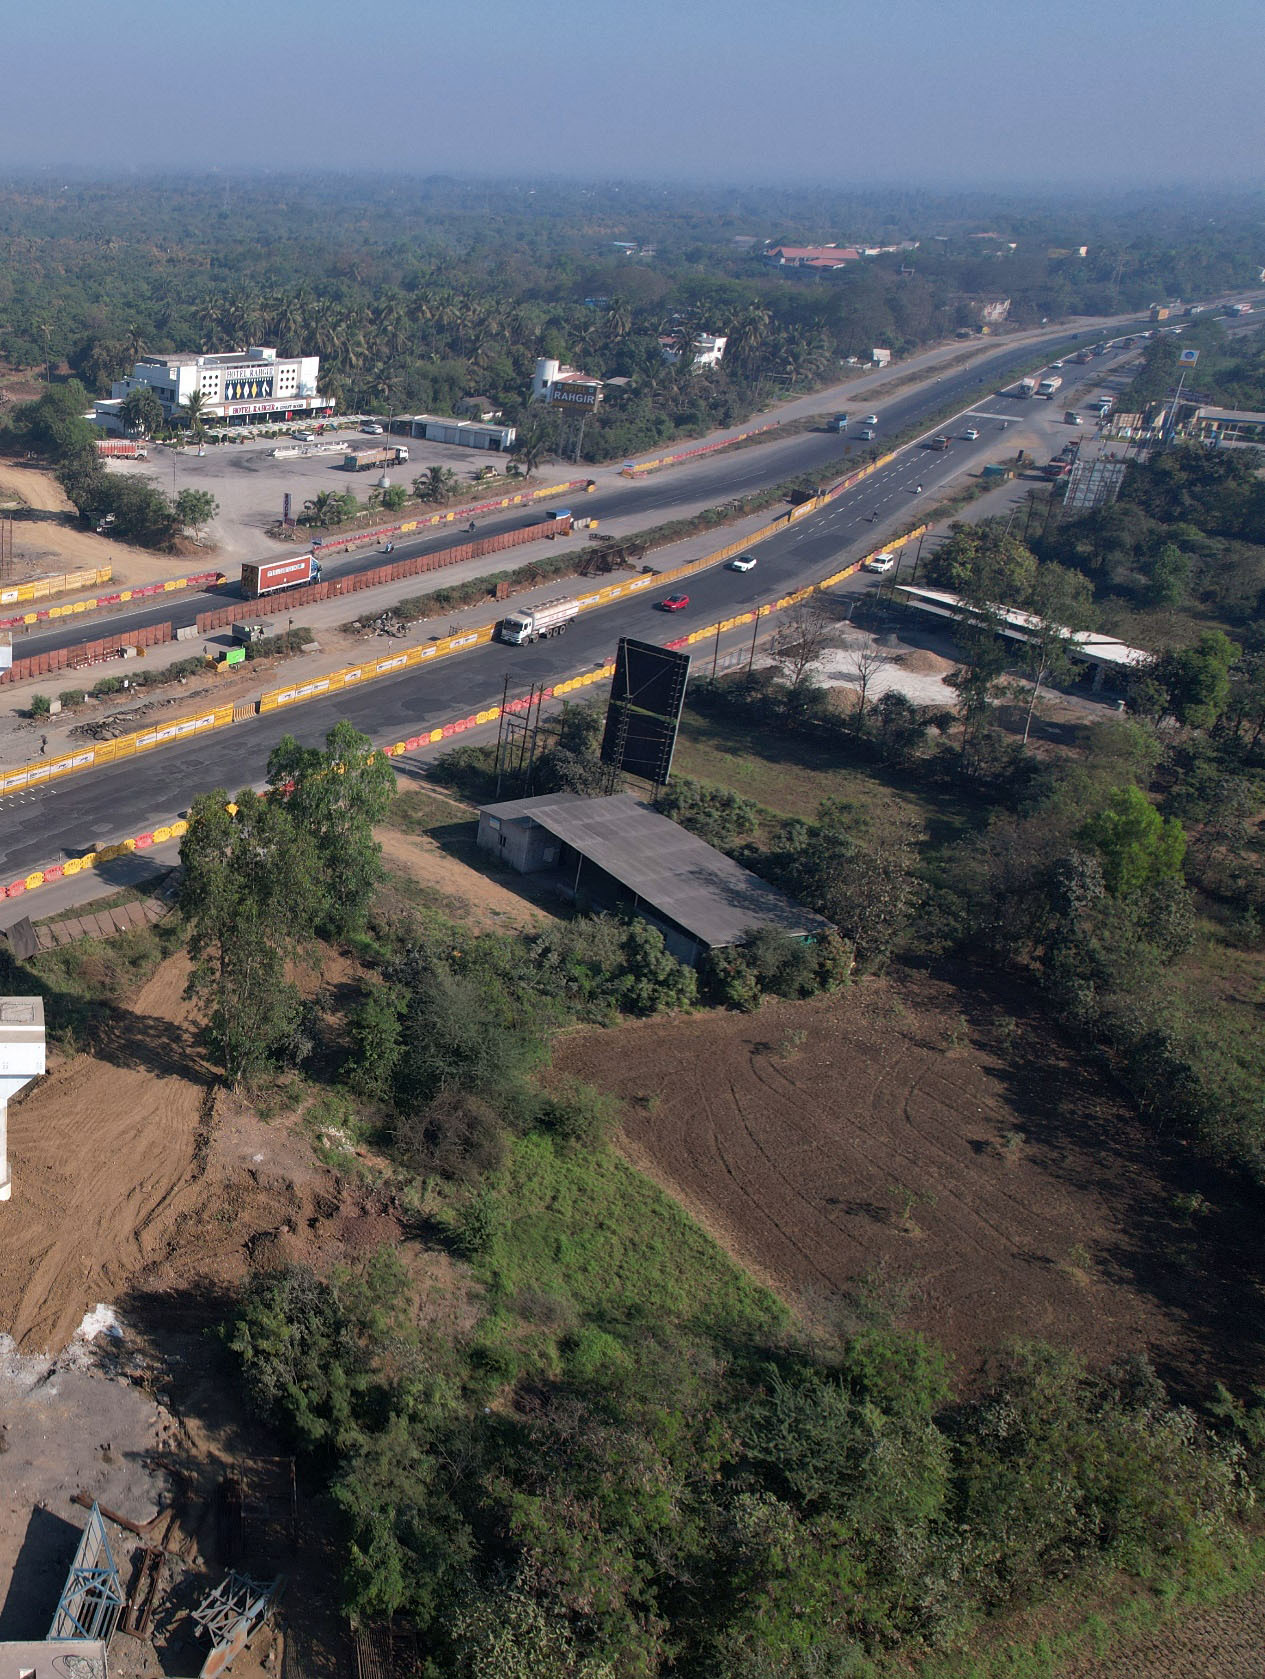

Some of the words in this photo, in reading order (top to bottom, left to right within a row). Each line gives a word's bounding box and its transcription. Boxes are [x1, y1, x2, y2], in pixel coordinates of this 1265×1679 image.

[226, 368, 247, 379] HOTEL
[249, 367, 274, 377] RAHGIR
[563, 384, 585, 392] HOTEL
[554, 391, 595, 404] RAHGIR
[232, 405, 252, 415] HOTEL
[252, 403, 276, 413] RAHGIR
